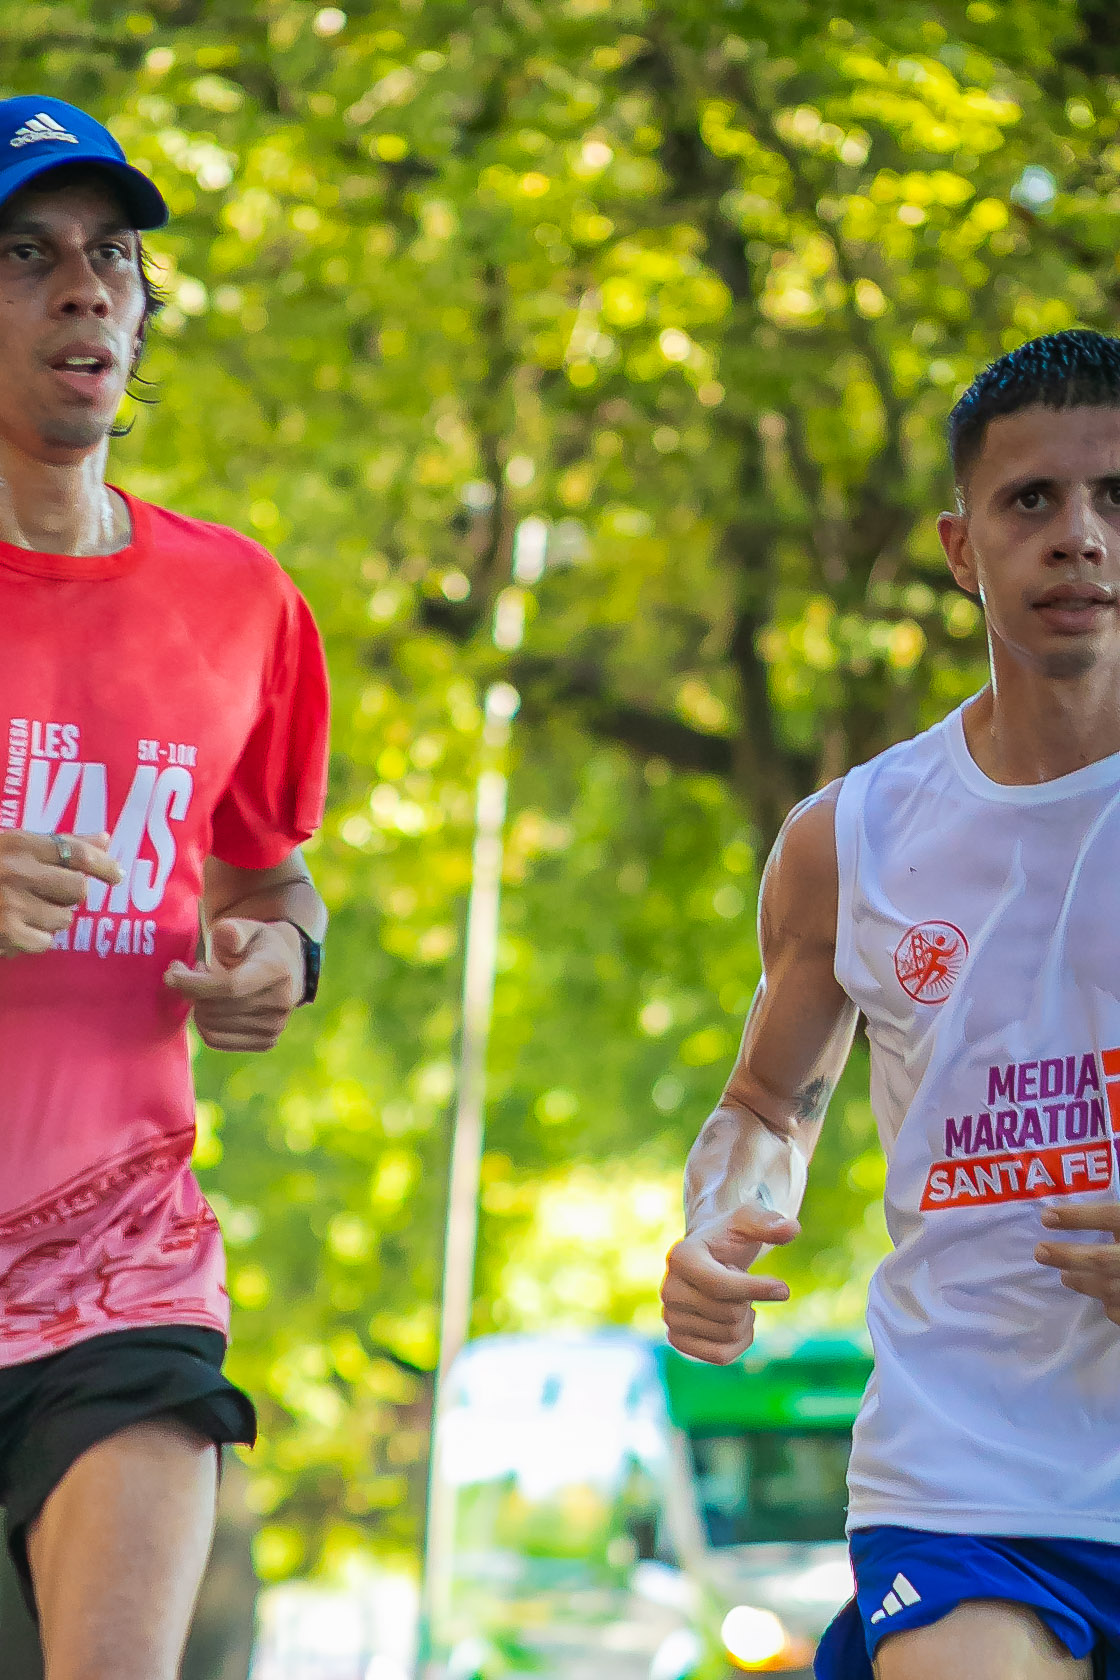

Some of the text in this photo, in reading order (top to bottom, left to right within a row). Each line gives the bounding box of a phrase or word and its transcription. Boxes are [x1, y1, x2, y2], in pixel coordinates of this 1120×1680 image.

[31, 720, 80, 760] LES
[987, 1052, 1100, 1106] MEDIA
[945, 1096, 1107, 1157] MARATON
[929, 1149, 1109, 1201] SANTA FE
